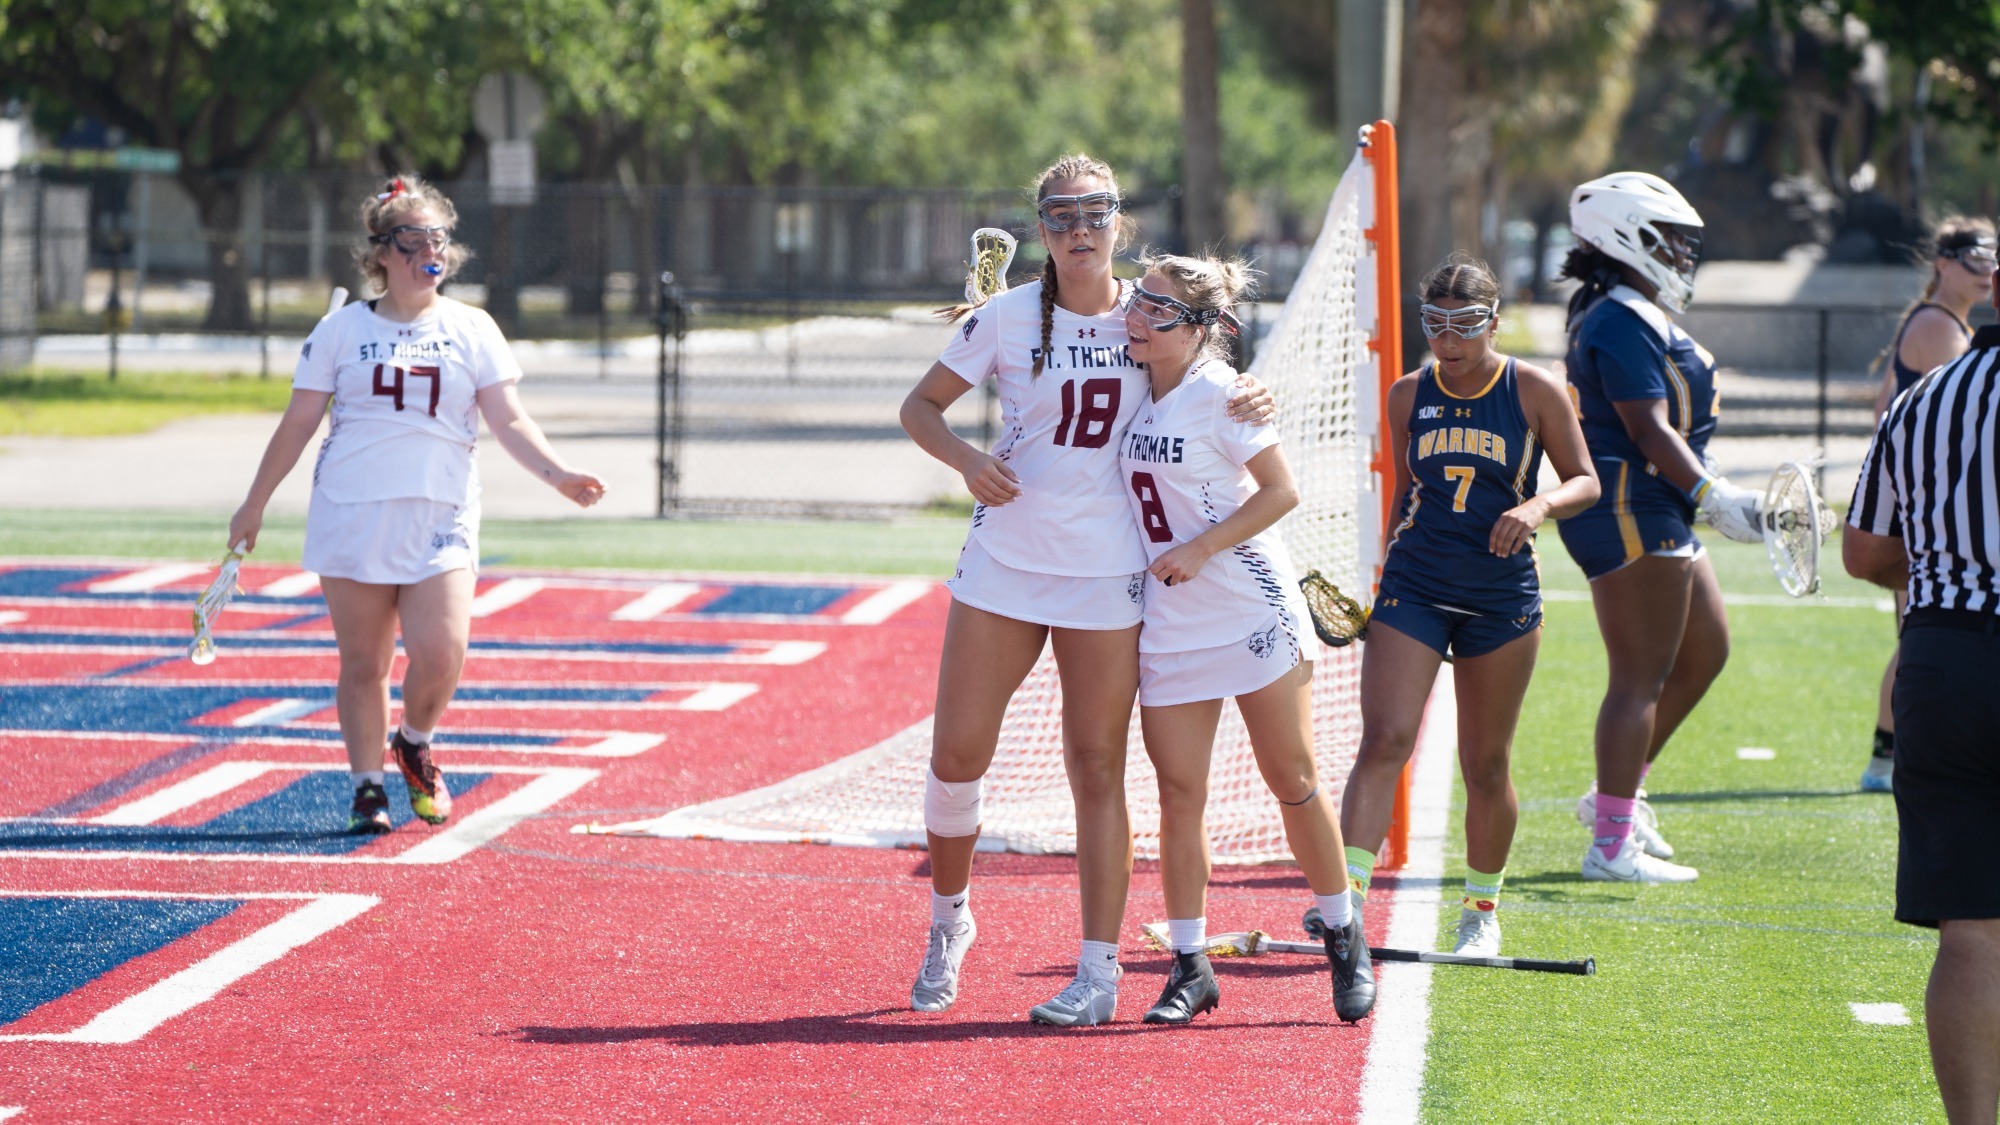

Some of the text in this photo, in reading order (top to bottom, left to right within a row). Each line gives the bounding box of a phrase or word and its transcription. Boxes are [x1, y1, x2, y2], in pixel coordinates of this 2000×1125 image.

[359, 341, 450, 361] ST. THOMAS
[1067, 344, 1144, 369] THOMA
[372, 363, 441, 417] 47
[1053, 378, 1122, 449] 18
[1128, 433, 1185, 463] THOMAS
[1418, 427, 1507, 466] WARNER
[1131, 471, 1173, 543] 8
[1444, 466, 1475, 513] 7
